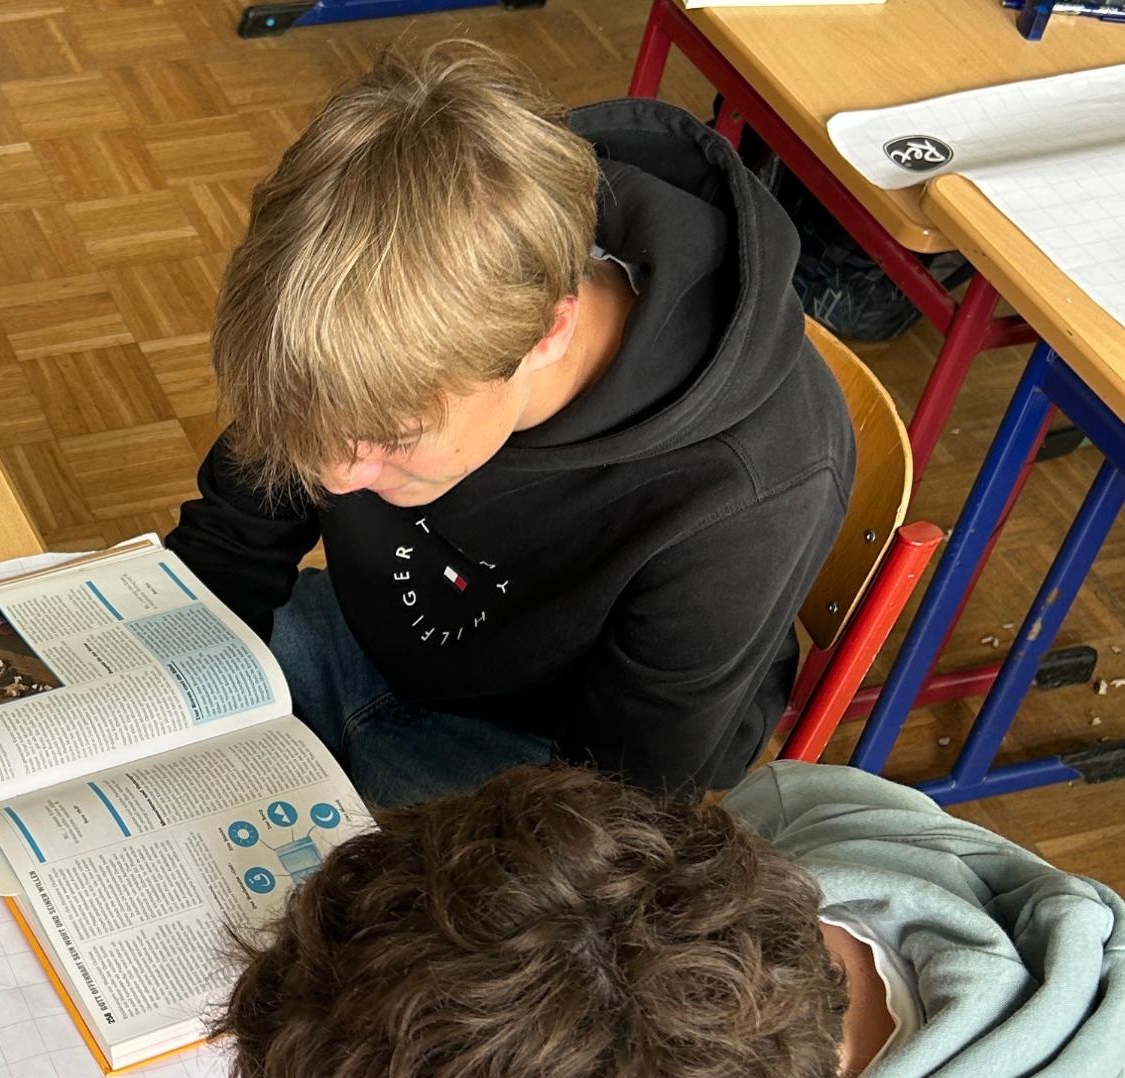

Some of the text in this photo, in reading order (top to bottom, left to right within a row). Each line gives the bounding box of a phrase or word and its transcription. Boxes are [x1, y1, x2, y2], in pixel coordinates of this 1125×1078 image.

[891, 140, 945, 163] Rex
[394, 545, 486, 646] HILFIGER
[29, 871, 115, 1024] 258 GOTT OFFENBART SEIN WORT UND SEINEN WILLEN
